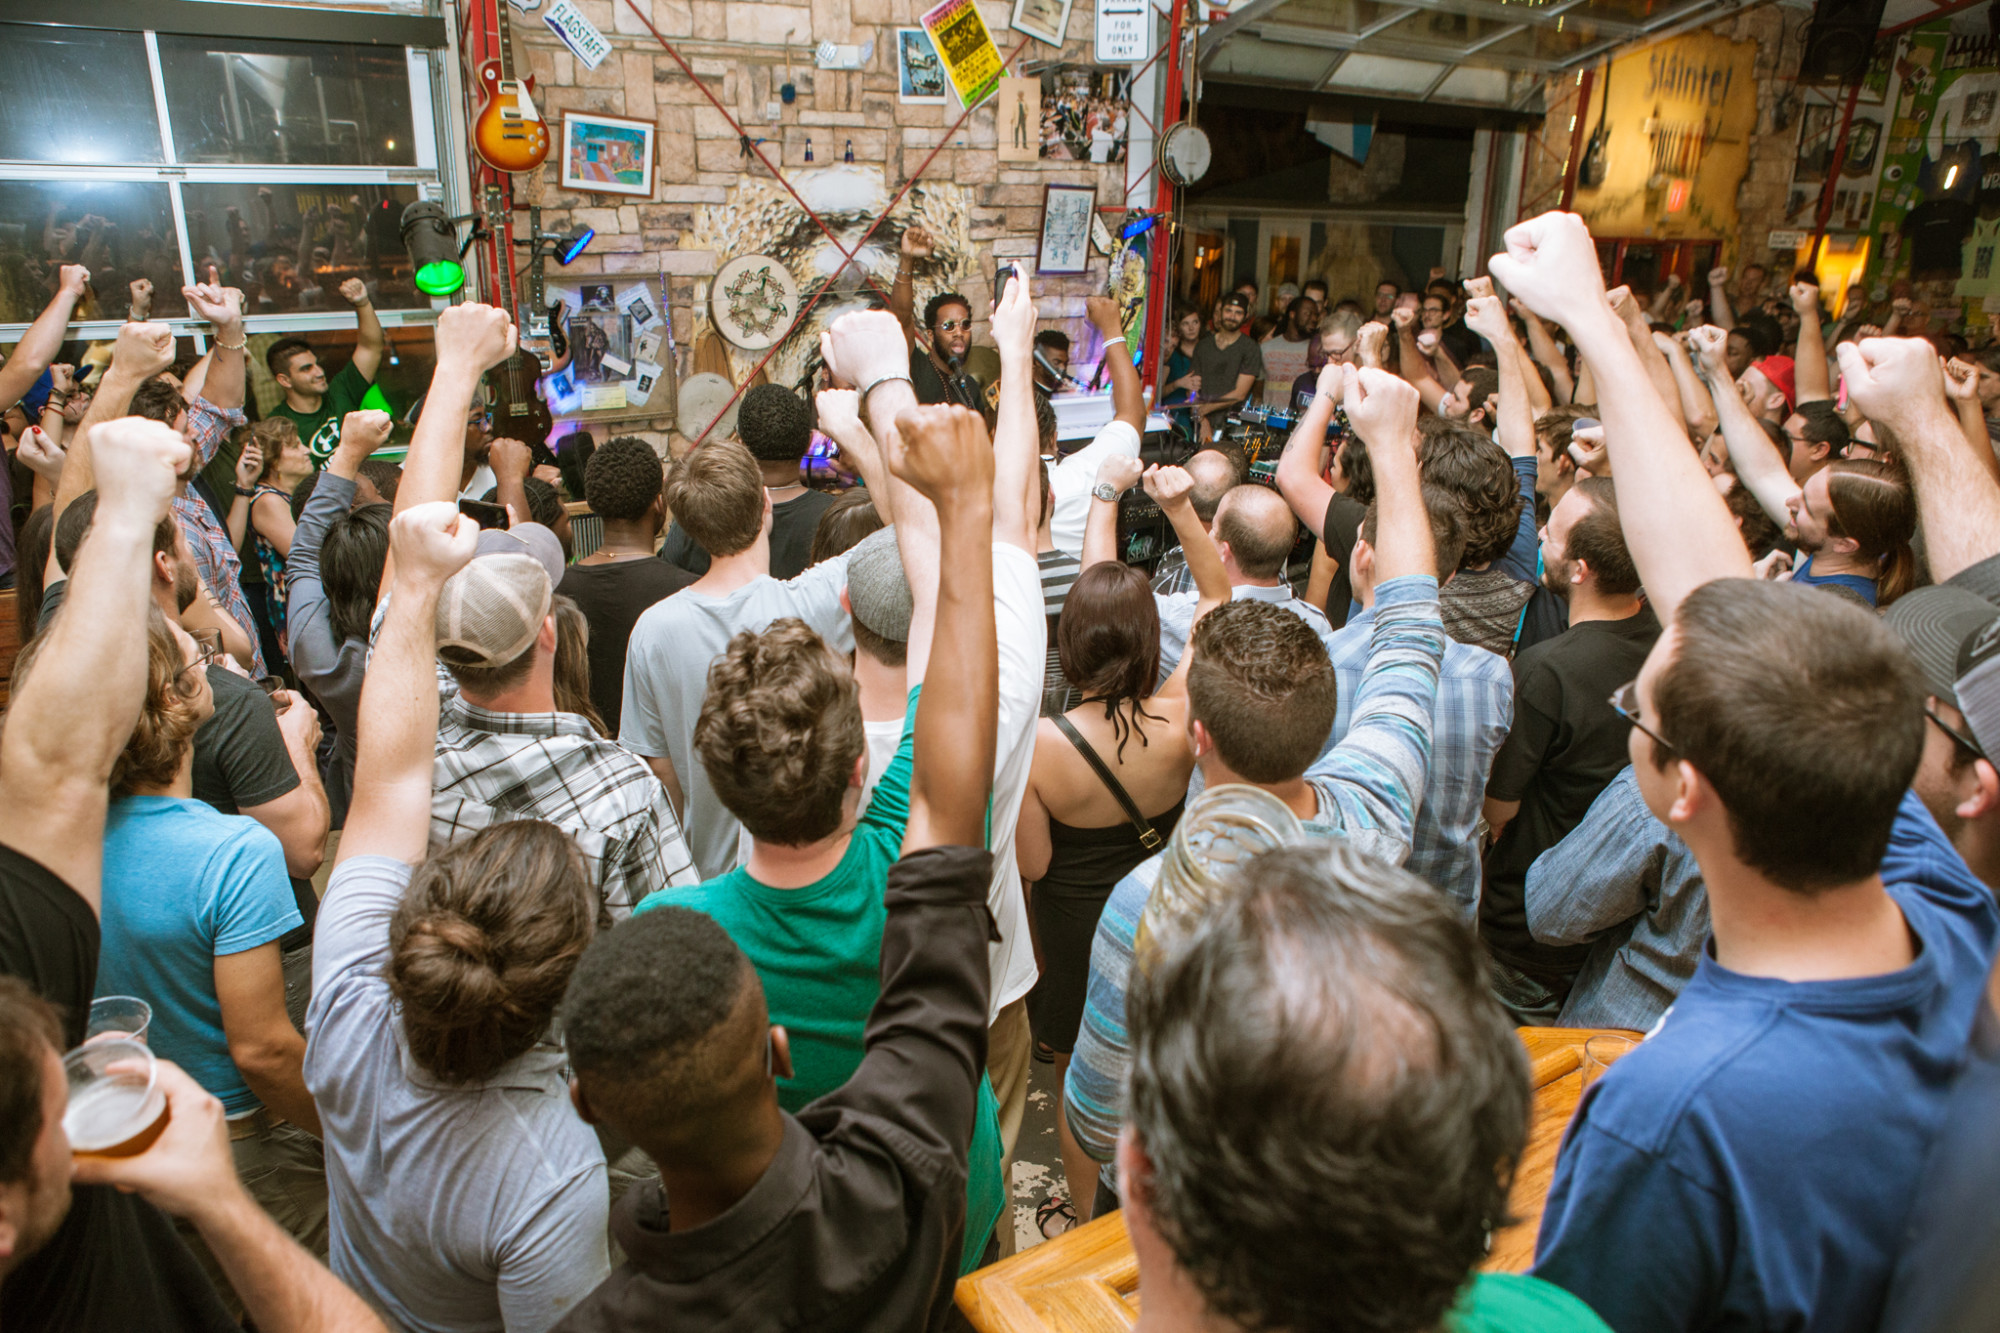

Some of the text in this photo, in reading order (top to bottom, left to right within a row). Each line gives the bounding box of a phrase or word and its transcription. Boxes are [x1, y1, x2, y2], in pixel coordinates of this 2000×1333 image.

[1114, 20, 1132, 30] FOR
[552, 3, 605, 58] FLAGSTAFF
[1107, 33, 1139, 42] PIPERS
[1111, 45, 1134, 55] ONLY
